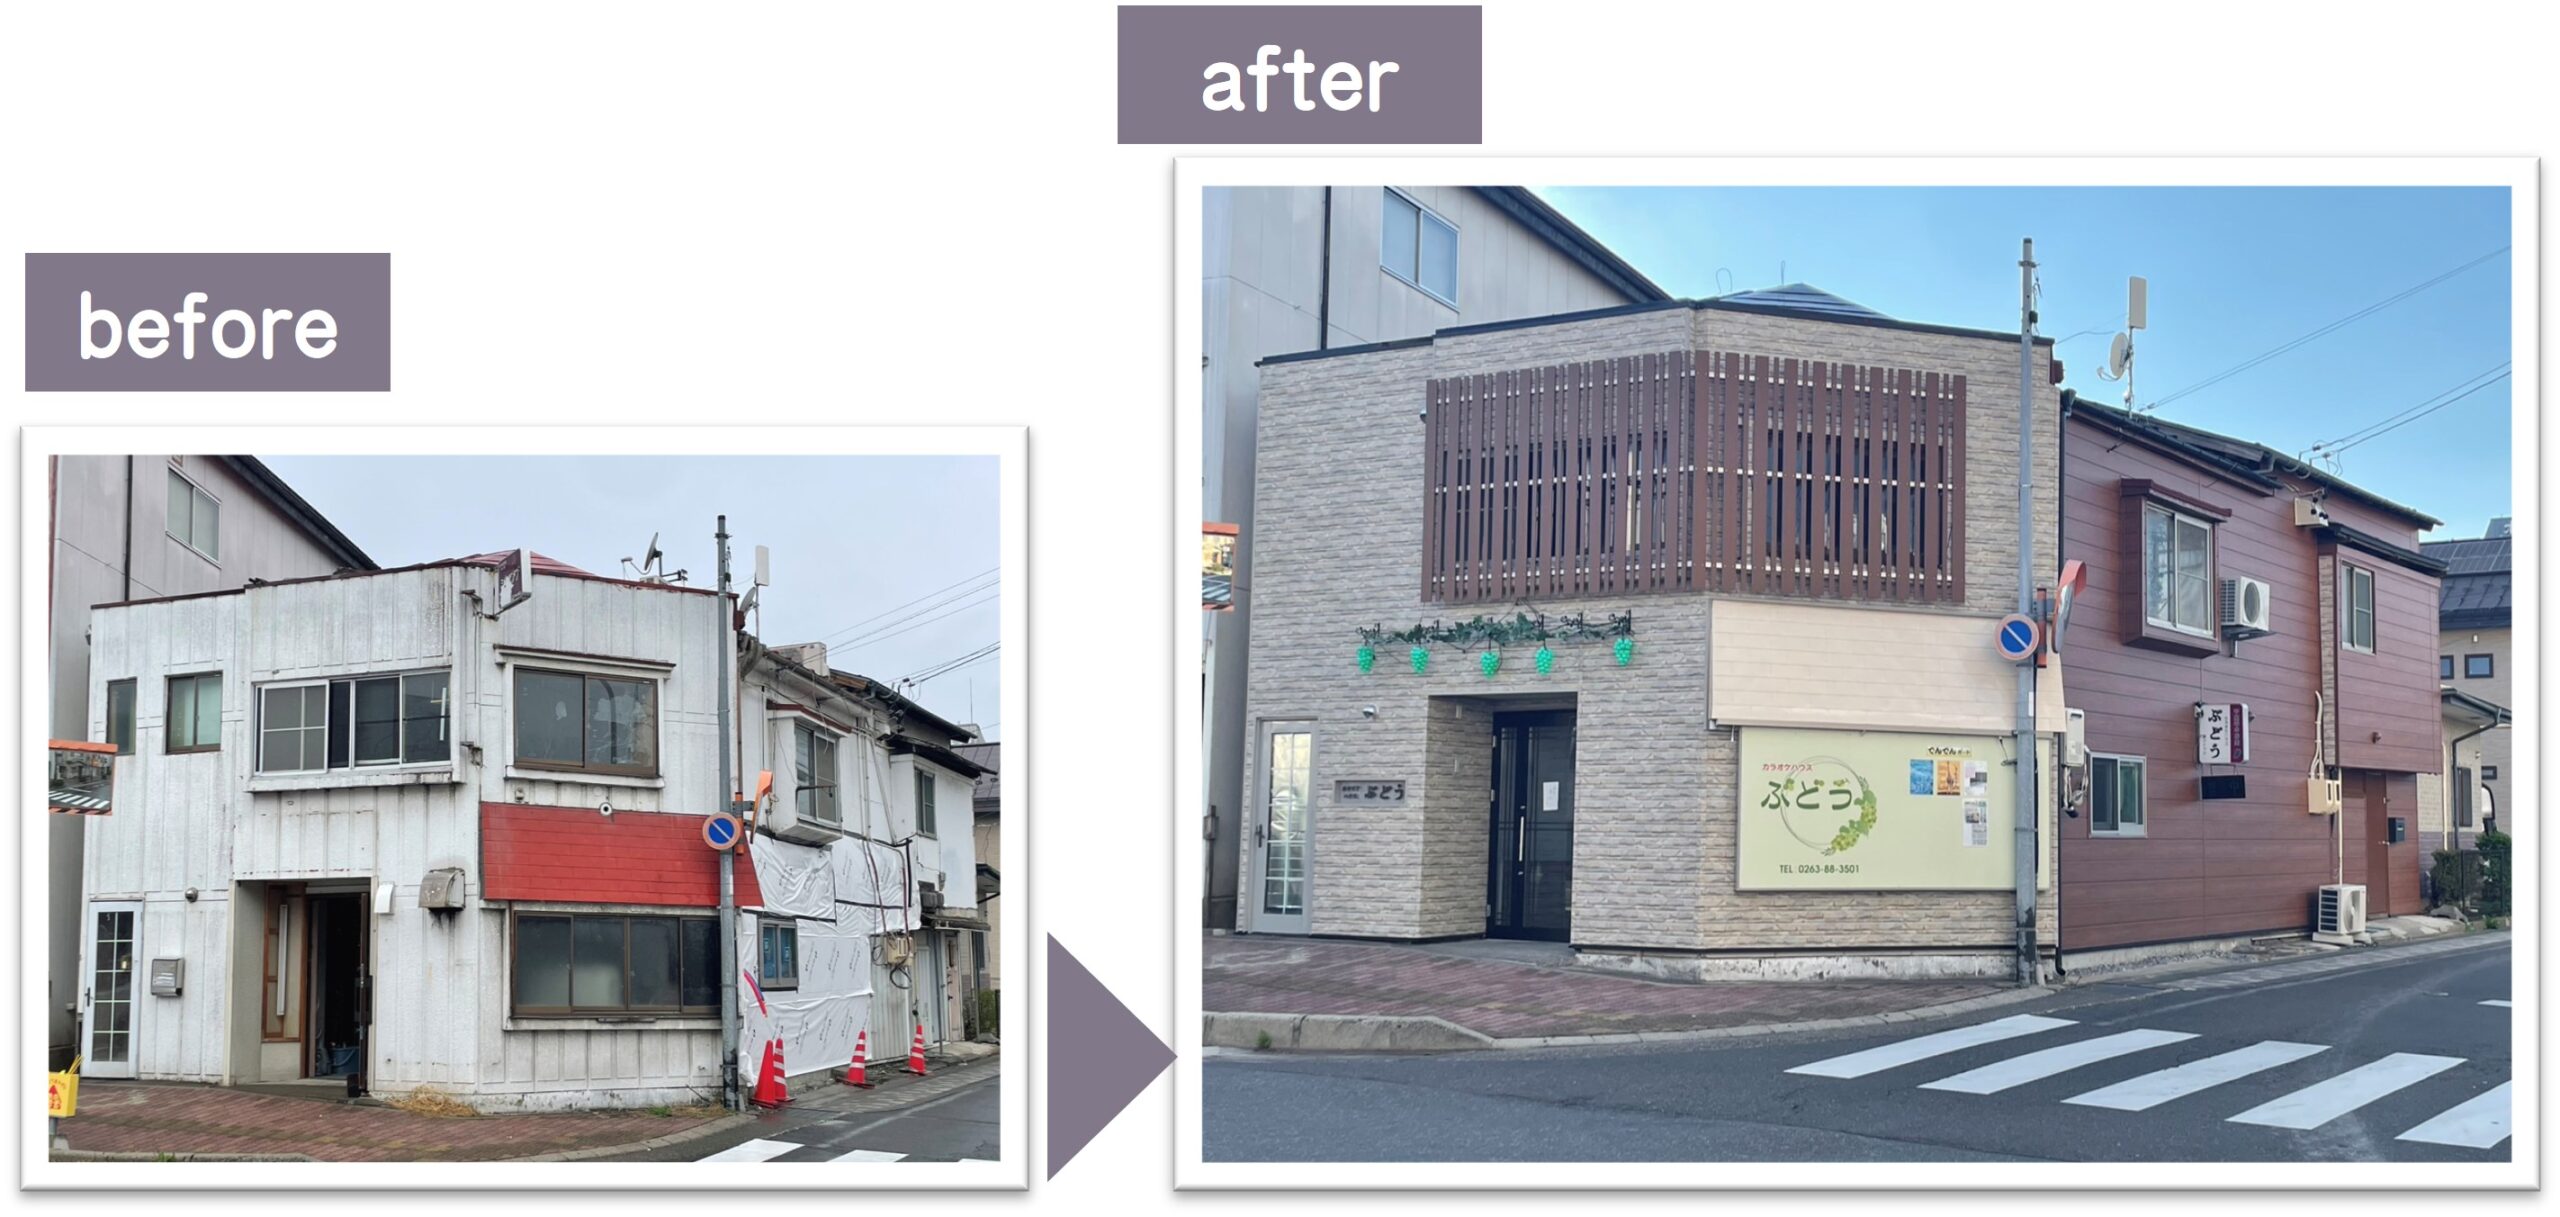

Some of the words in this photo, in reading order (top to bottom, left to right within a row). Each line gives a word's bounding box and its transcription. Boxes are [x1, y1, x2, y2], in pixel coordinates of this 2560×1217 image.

[2208, 709, 2223, 759] ぶどう
[1762, 763, 1813, 772] カラオケハウス
[1364, 784, 1405, 801] ぶどう
[1761, 778, 1853, 810] ぶどう
[1798, 864, 1859, 874] 0263-88-3501
